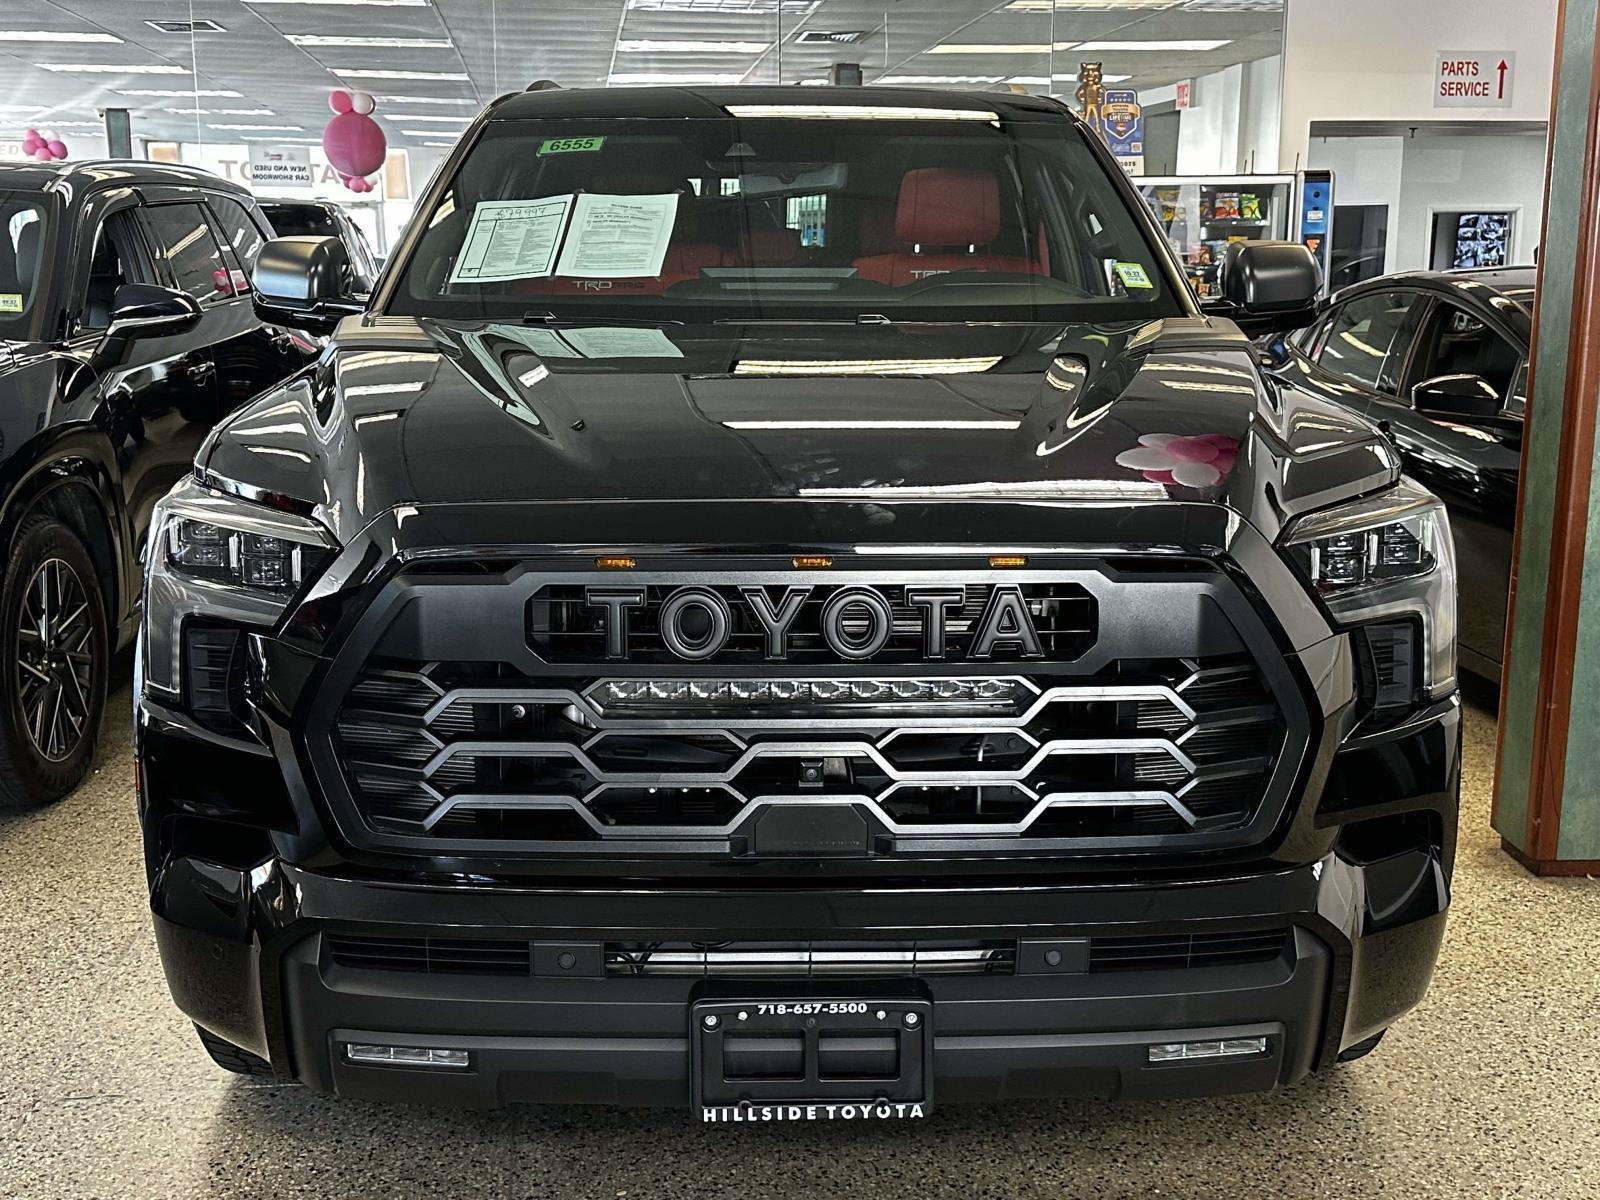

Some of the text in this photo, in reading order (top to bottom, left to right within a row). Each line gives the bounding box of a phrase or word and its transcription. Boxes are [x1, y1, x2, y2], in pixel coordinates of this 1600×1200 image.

[1441, 61, 1479, 76] PARTS
[1440, 82, 1490, 97] SERVICE
[550, 139, 595, 151] 6555
[572, 280, 612, 291] TRD
[585, 584, 1045, 660] TOYOTA
[757, 1003, 867, 1015] 718-657-5500
[703, 1104, 924, 1123] HILLSIDE TOYOTA
